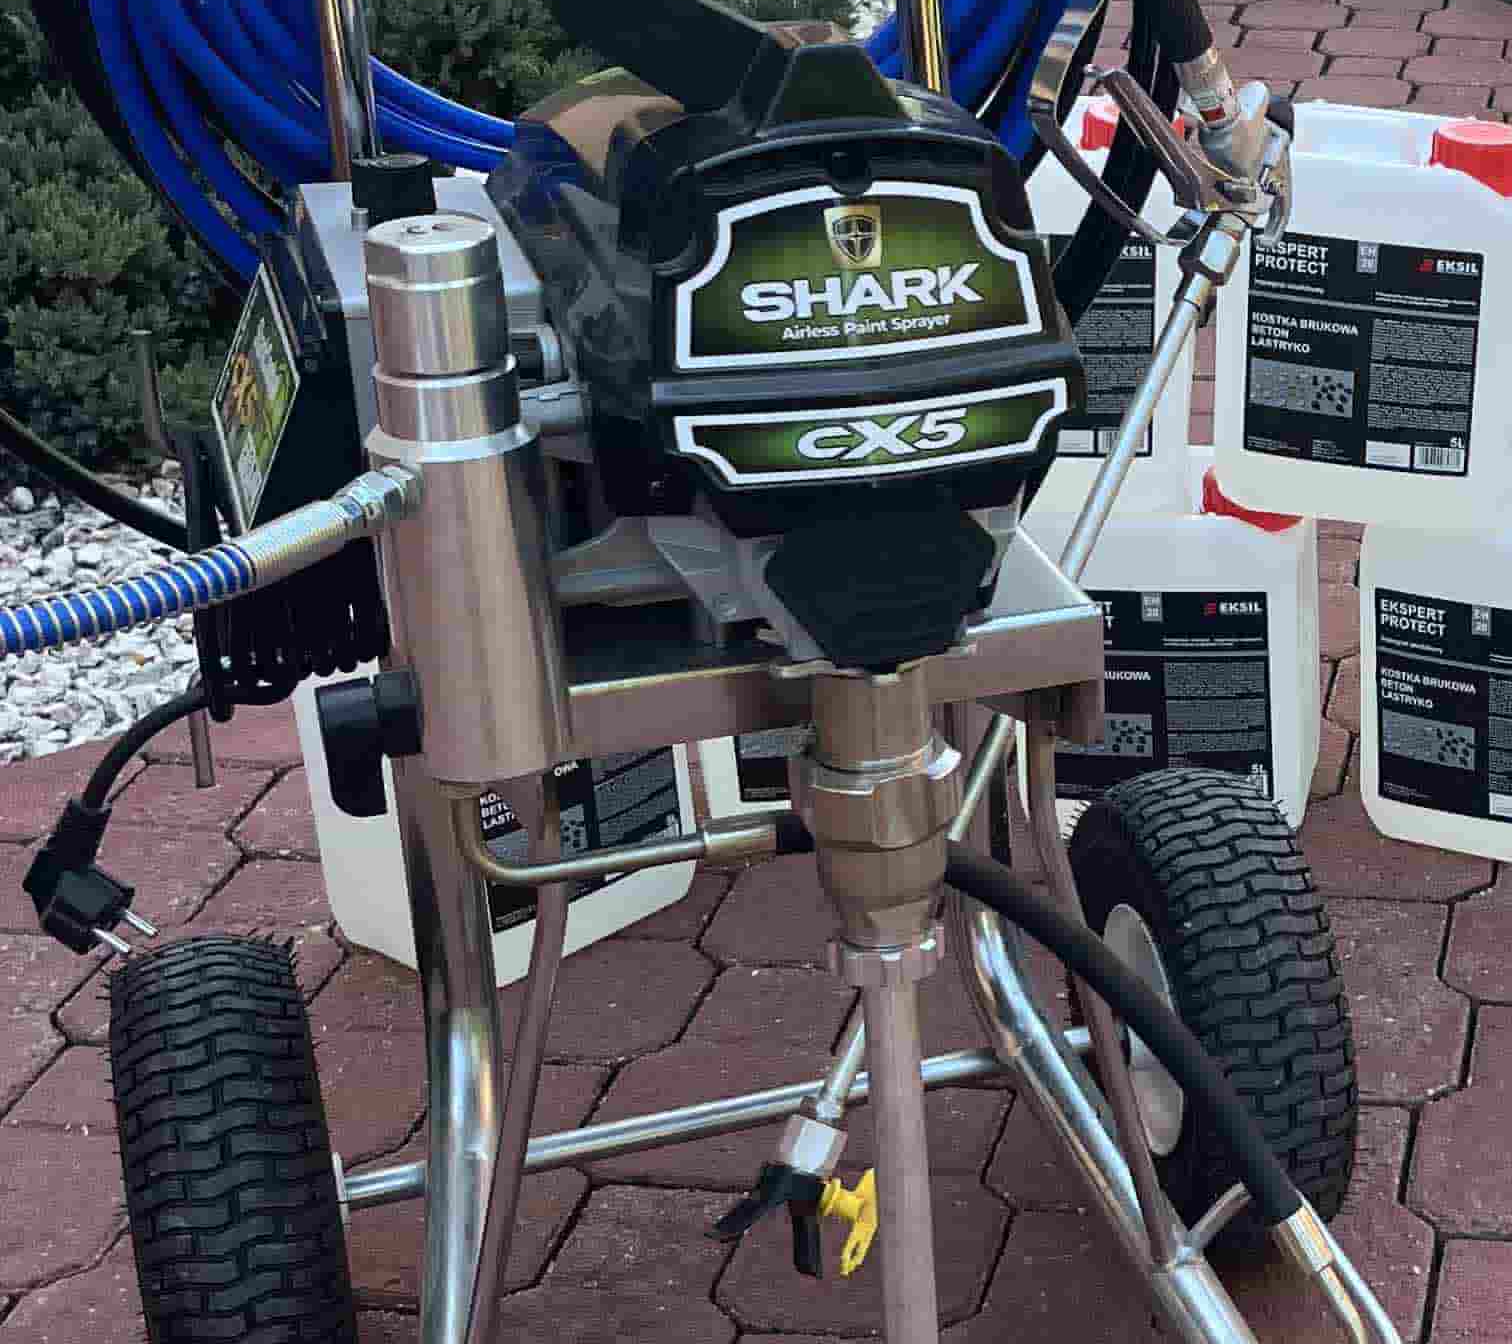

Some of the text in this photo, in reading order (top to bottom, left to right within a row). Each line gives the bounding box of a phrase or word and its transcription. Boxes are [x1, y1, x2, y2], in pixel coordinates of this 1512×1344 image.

[1255, 253, 1329, 276] PROTECT
[1436, 259, 1480, 273] EKSIL
[740, 262, 985, 323] SHARK
[782, 313, 953, 341] Airless Paint Sprayer
[797, 406, 969, 460] CX5
[1218, 601, 1264, 614] EKSIL
[1380, 598, 1447, 623] EKSPERT
[1380, 613, 1447, 637] PROTECT
